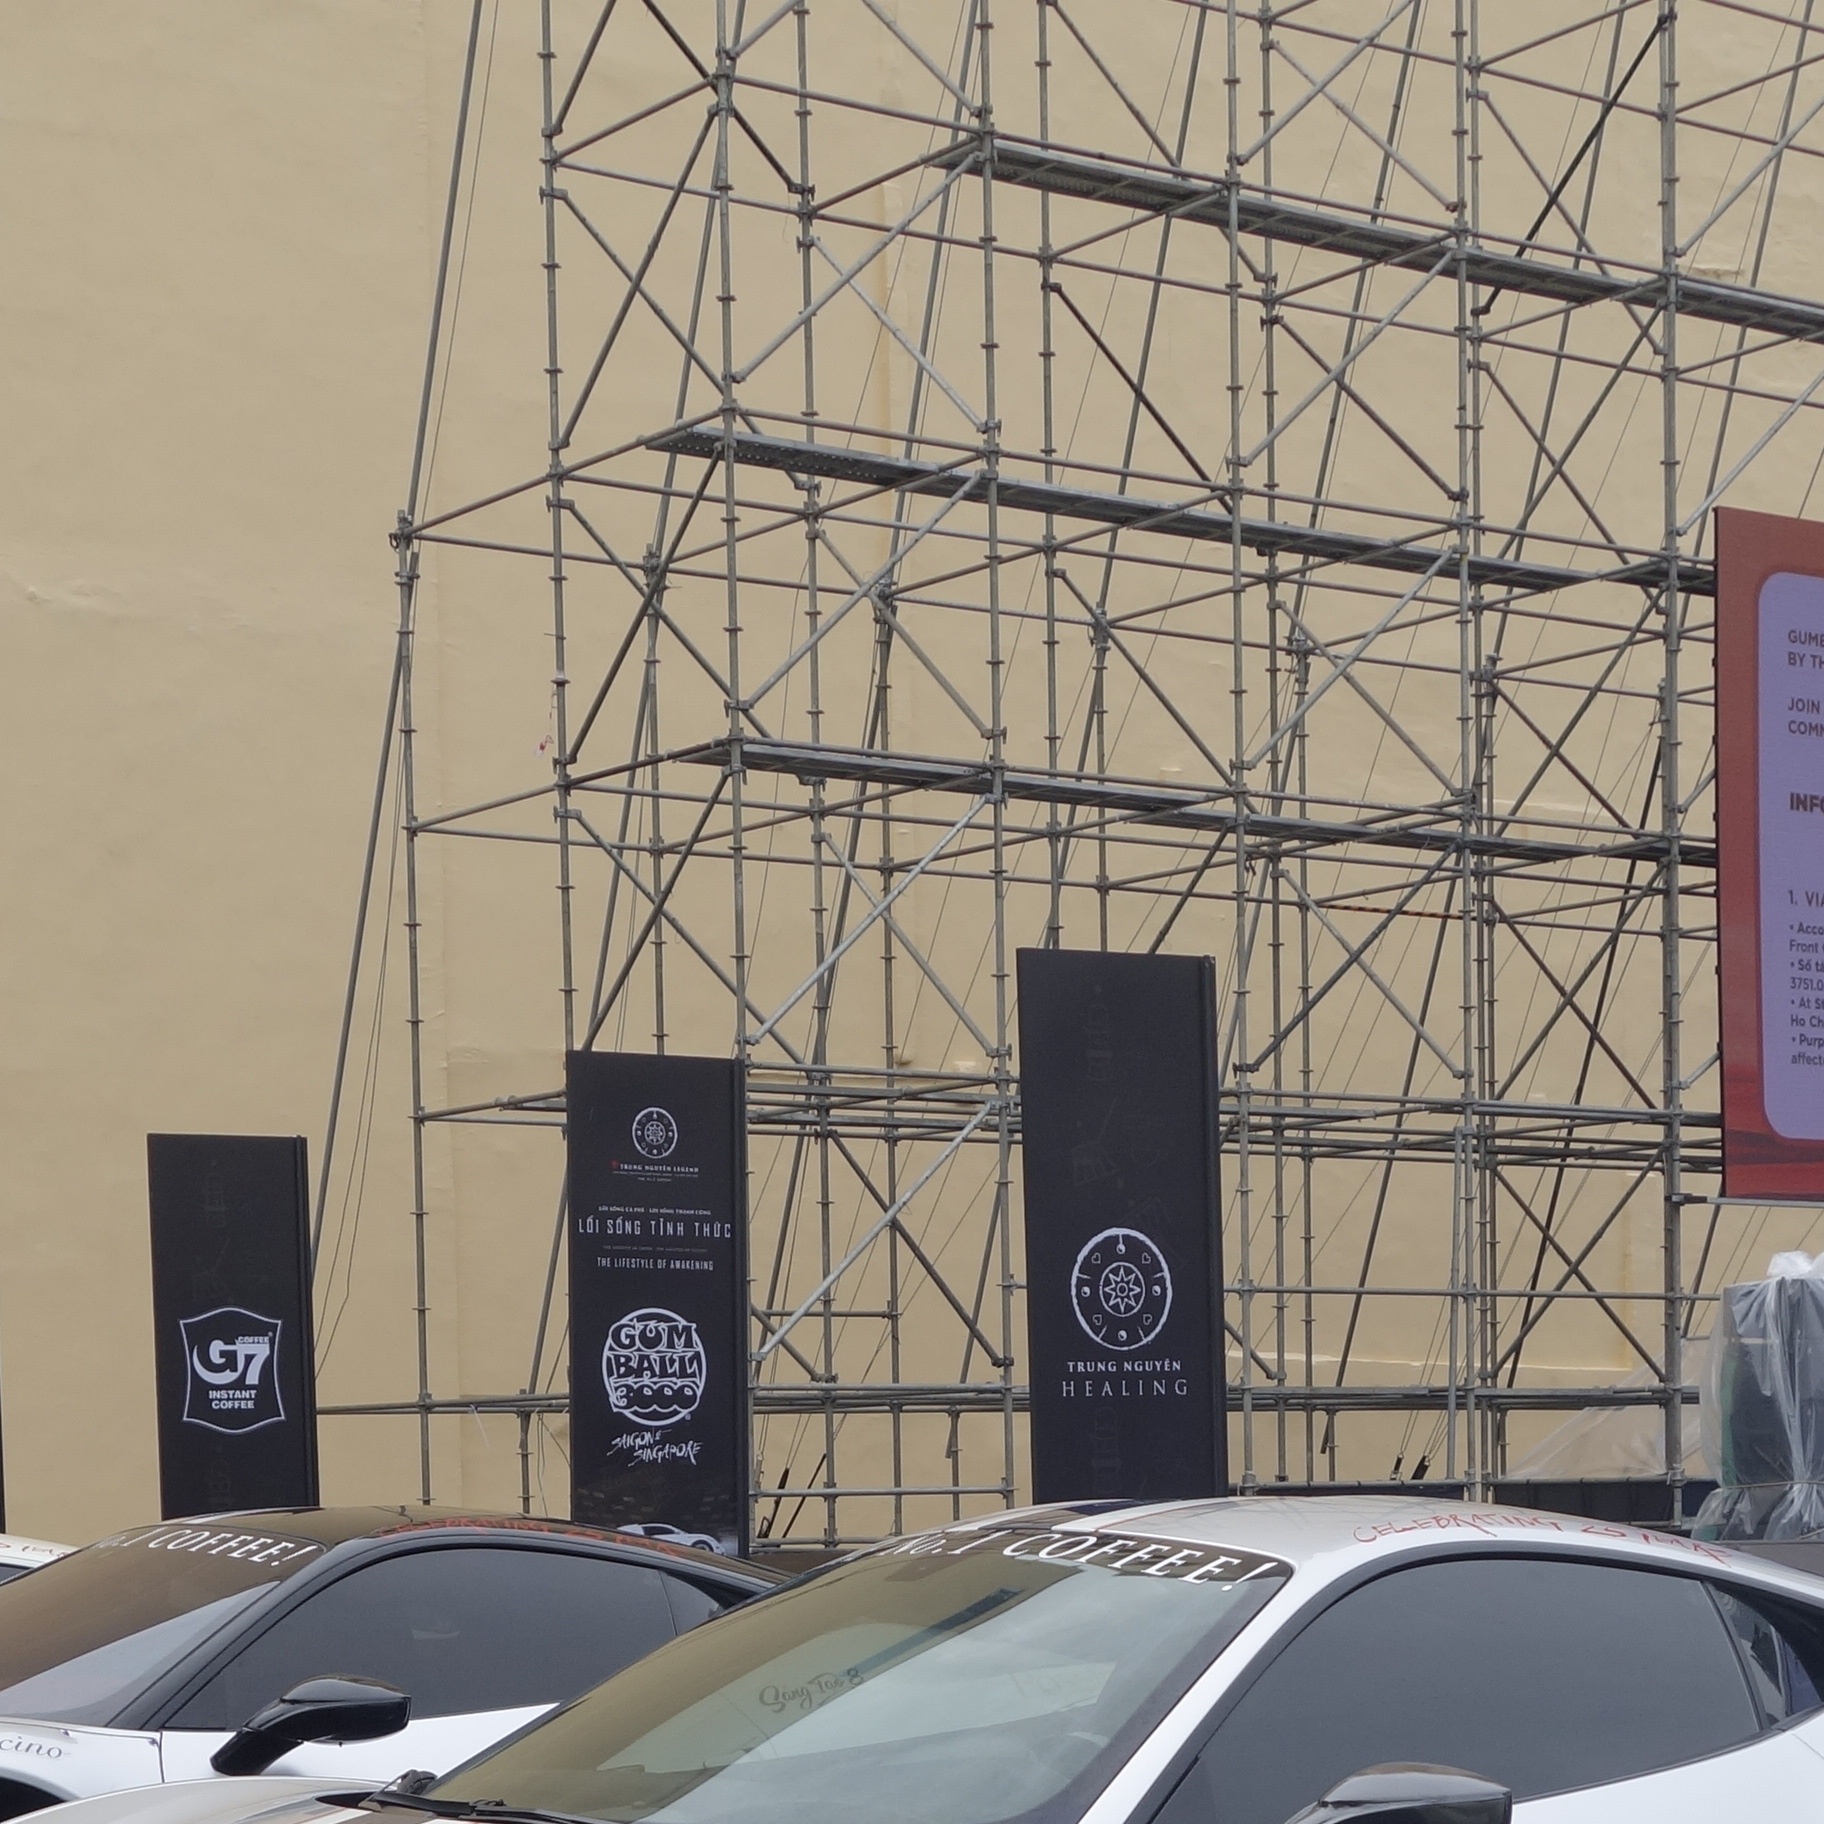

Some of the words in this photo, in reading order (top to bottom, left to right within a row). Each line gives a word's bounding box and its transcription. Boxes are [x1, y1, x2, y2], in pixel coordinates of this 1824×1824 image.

[1787, 650, 1805, 668] BY
[1788, 696, 1820, 715] JOIN
[607, 1216, 641, 1236] SỐNG
[597, 1256, 611, 1267] THE
[614, 1257, 654, 1269] LIFESTYLE
[657, 1259, 667, 1269] OF
[670, 1259, 714, 1271] AWAKENING
[237, 1336, 270, 1344] COFFEE
[609, 1318, 697, 1351] GUM
[192, 1339, 270, 1385] G7
[608, 1351, 702, 1381] BALL
[1067, 1361, 1117, 1372] TRUNG
[1123, 1358, 1181, 1372] NGUYÊN
[208, 1390, 257, 1399] INSTANT
[609, 1381, 700, 1413] 3000
[1062, 1379, 1188, 1397] HEALING
[211, 1400, 255, 1409] COFFEE
[628, 1441, 704, 1467] SINGAPORE
[1352, 1511, 1564, 1545] CELEBRATING
[147, 1531, 317, 1567] COFFEE!
[1002, 1533, 1278, 1592] COFFEE!
